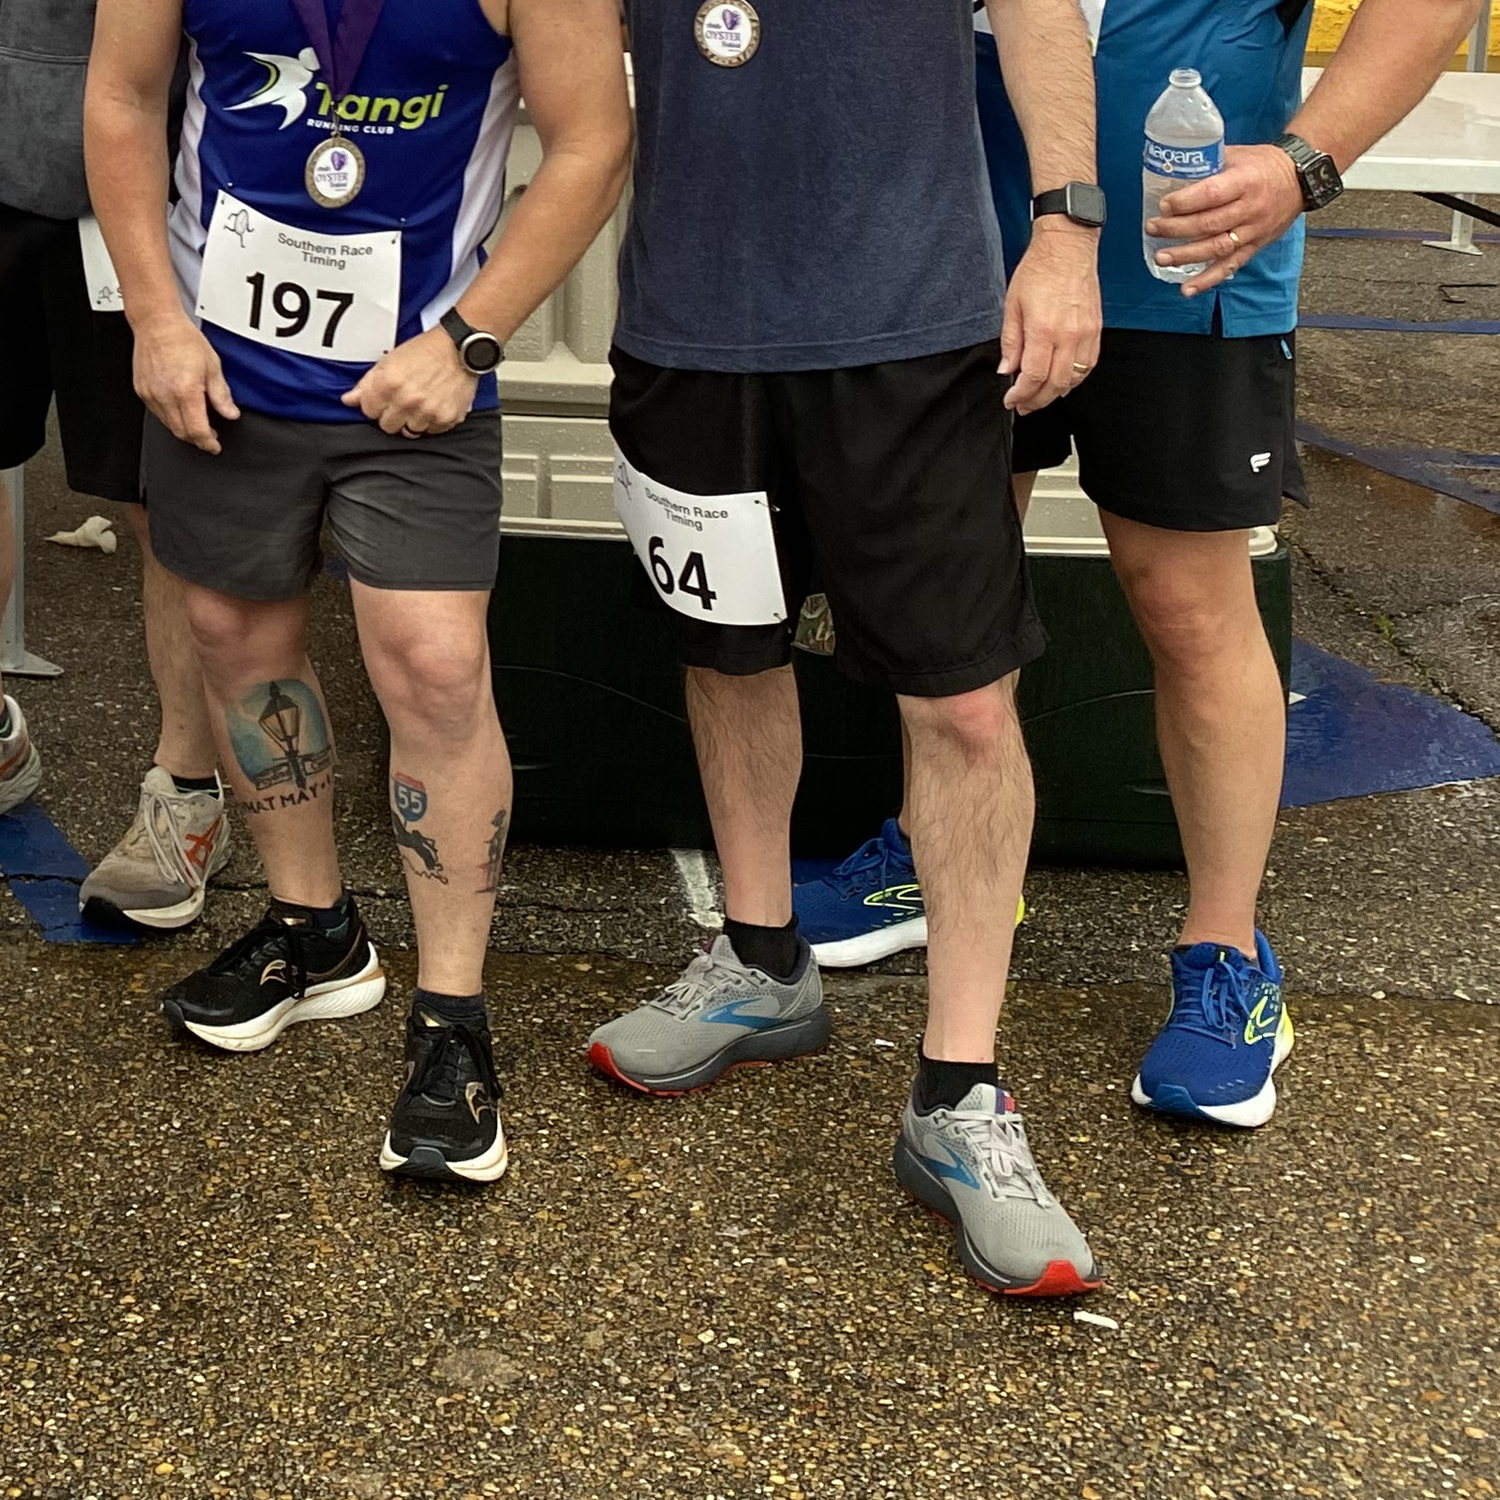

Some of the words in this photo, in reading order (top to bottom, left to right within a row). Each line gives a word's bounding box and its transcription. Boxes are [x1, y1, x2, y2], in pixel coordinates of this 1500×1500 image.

[363, 125, 394, 135] CLUB
[277, 232, 337, 256] Southern
[341, 245, 373, 256] Race
[301, 251, 346, 270] Timing
[246, 271, 354, 348] 197
[645, 487, 691, 516] Southern
[693, 506, 729, 519] Race
[664, 508, 703, 532] Timing
[648, 536, 717, 611] 64
[398, 785, 423, 815] 55
